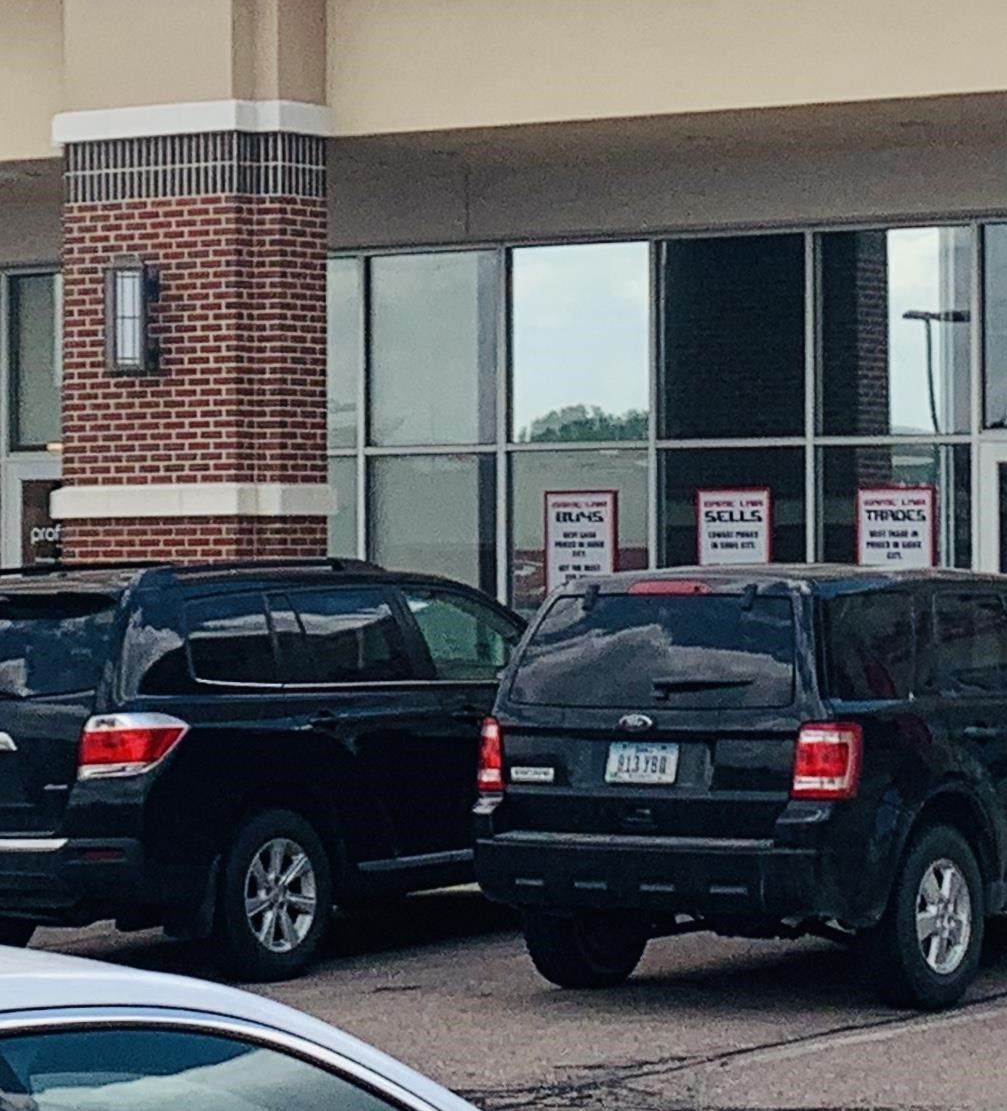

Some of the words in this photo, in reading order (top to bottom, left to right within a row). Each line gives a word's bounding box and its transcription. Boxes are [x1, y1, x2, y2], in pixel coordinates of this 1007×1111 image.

[555, 510, 605, 524] BUYS
[704, 509, 763, 523] SELLS
[865, 508, 927, 522] TRADES
